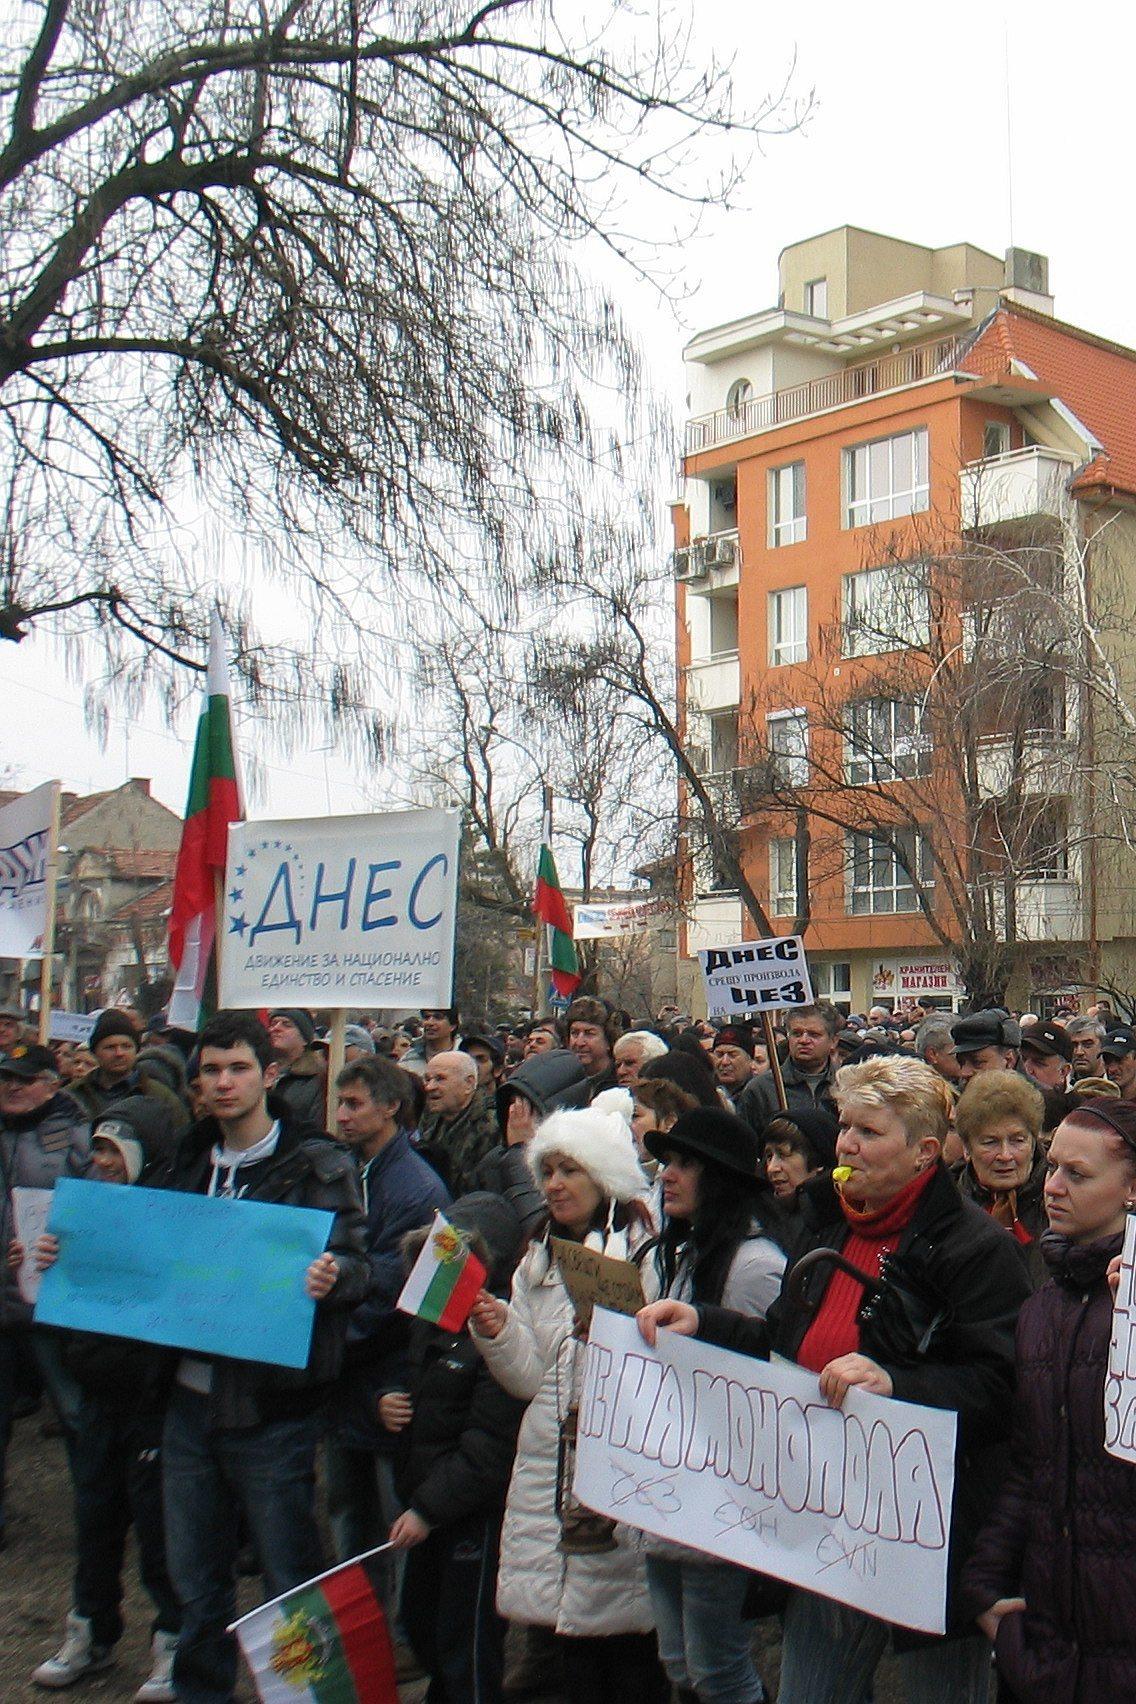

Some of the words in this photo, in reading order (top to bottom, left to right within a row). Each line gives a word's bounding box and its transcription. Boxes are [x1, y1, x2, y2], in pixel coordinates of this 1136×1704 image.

[249, 852, 450, 947] ДНЕС
[244, 953, 318, 971] ДВИЖЕНИЕ
[321, 952, 339, 968] ЗА
[343, 951, 441, 969] НАЦИОНАЛНО
[706, 939, 799, 976] ДНЕС
[261, 972, 331, 989] ЕДИНСТВО
[335, 973, 346, 987] И
[350, 971, 423, 987] СПАСЕНИЕ
[709, 974, 741, 987] СРЕЩУ
[743, 968, 801, 983] ПРОИЗВОЛА
[901, 974, 948, 988] МАГАЗИН
[730, 981, 806, 1006] ЧЕЗ
[686, 1368, 946, 1549] МОНОПОЛА
